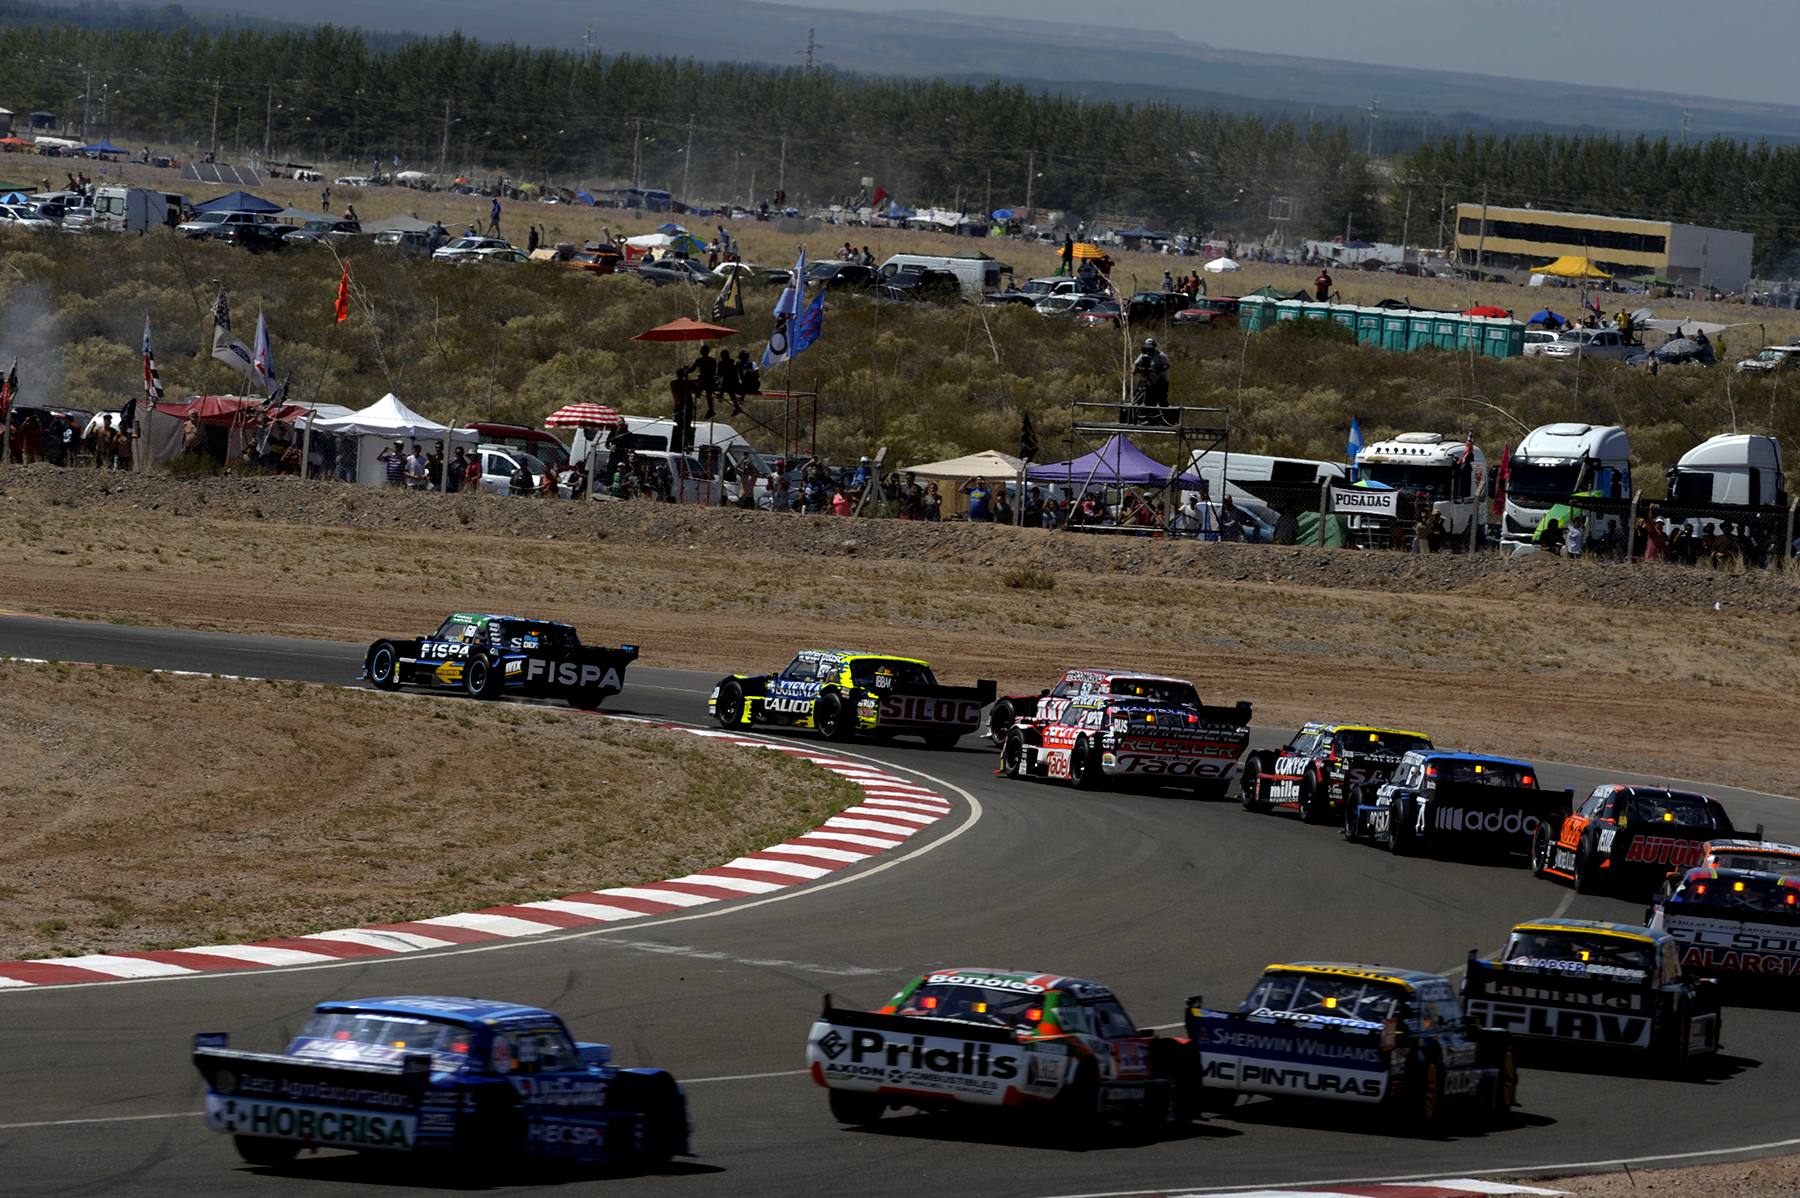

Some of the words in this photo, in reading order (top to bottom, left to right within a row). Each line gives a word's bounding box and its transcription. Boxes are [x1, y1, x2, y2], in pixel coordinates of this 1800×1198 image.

[1335, 493, 1391, 507] POSADAS
[505, 660, 522, 672] WIX
[526, 658, 621, 690] FISPA
[763, 698, 810, 713] CALICO
[852, 1030, 1017, 1080] Prialis
[1243, 1066, 1380, 1097] PINTURAS
